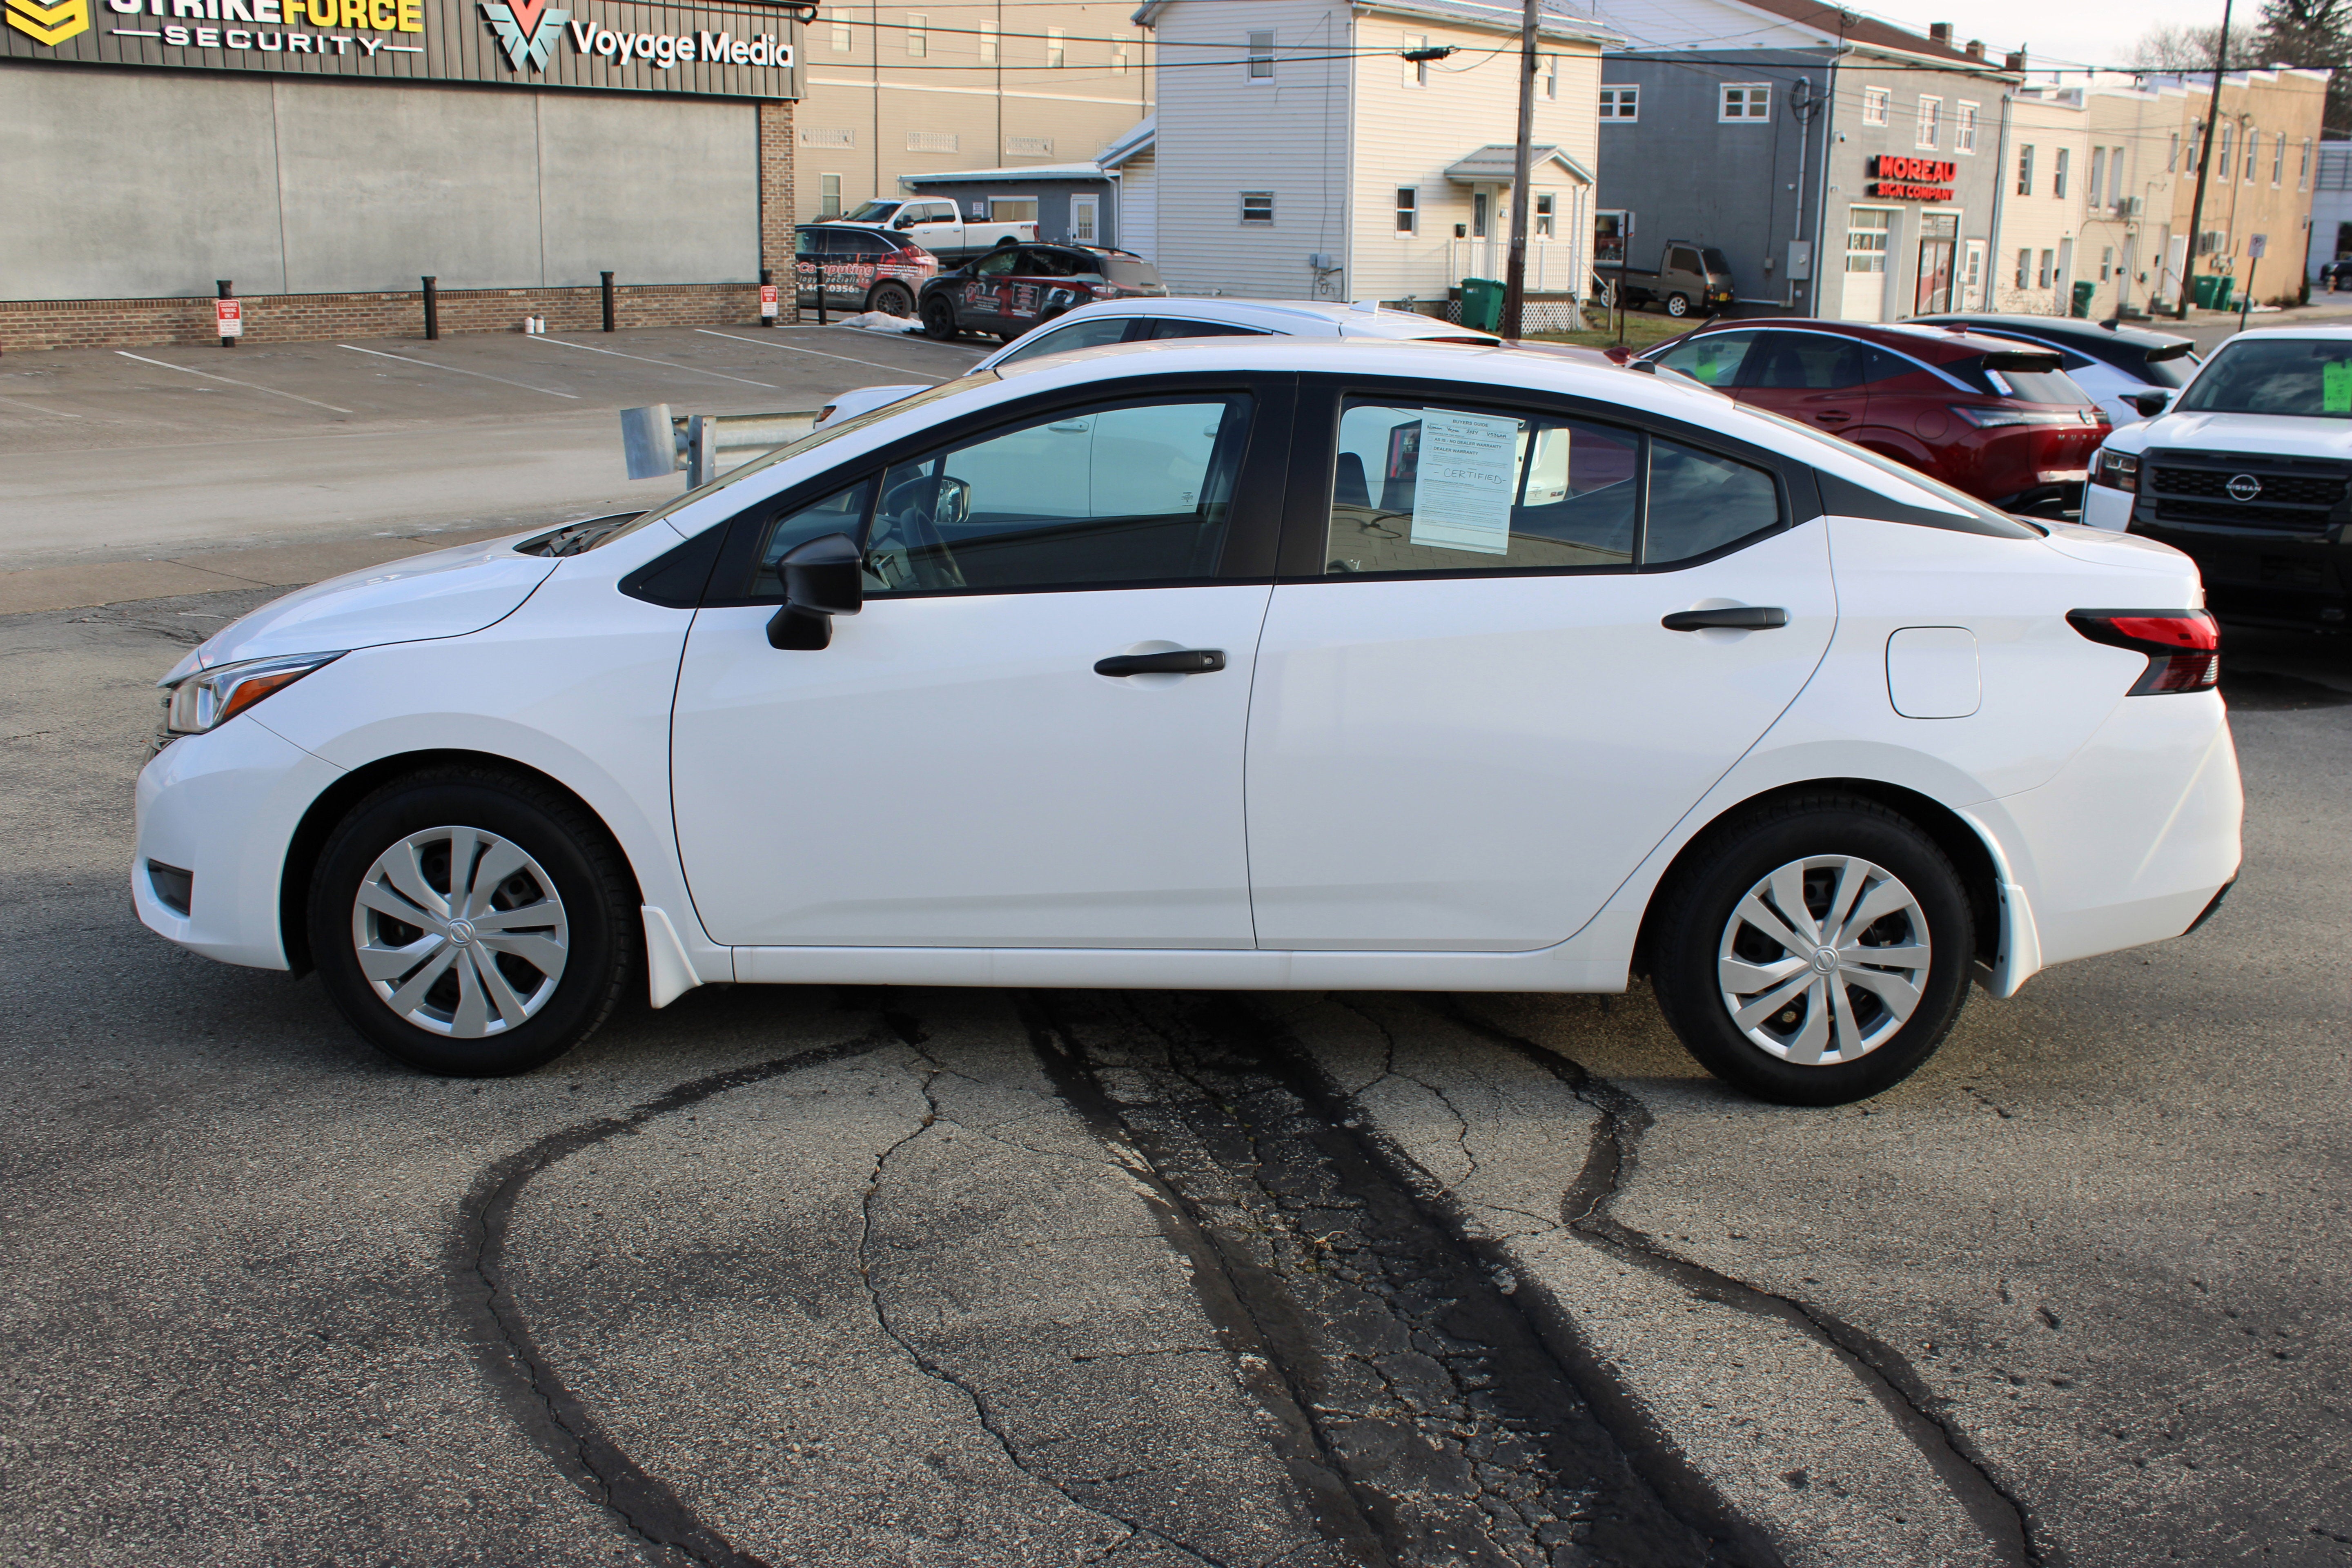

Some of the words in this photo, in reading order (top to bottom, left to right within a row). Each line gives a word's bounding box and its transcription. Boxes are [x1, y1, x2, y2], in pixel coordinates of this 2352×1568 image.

[165, 25, 383, 56] SECURITY
[571, 20, 695, 69] Voyage
[701, 30, 794, 68] Media
[1879, 154, 1957, 182] MOREAU
[1878, 182, 1905, 197] SIGN
[1907, 185, 1955, 200] COMPANY
[799, 283, 855, 293] 4.46.0356
